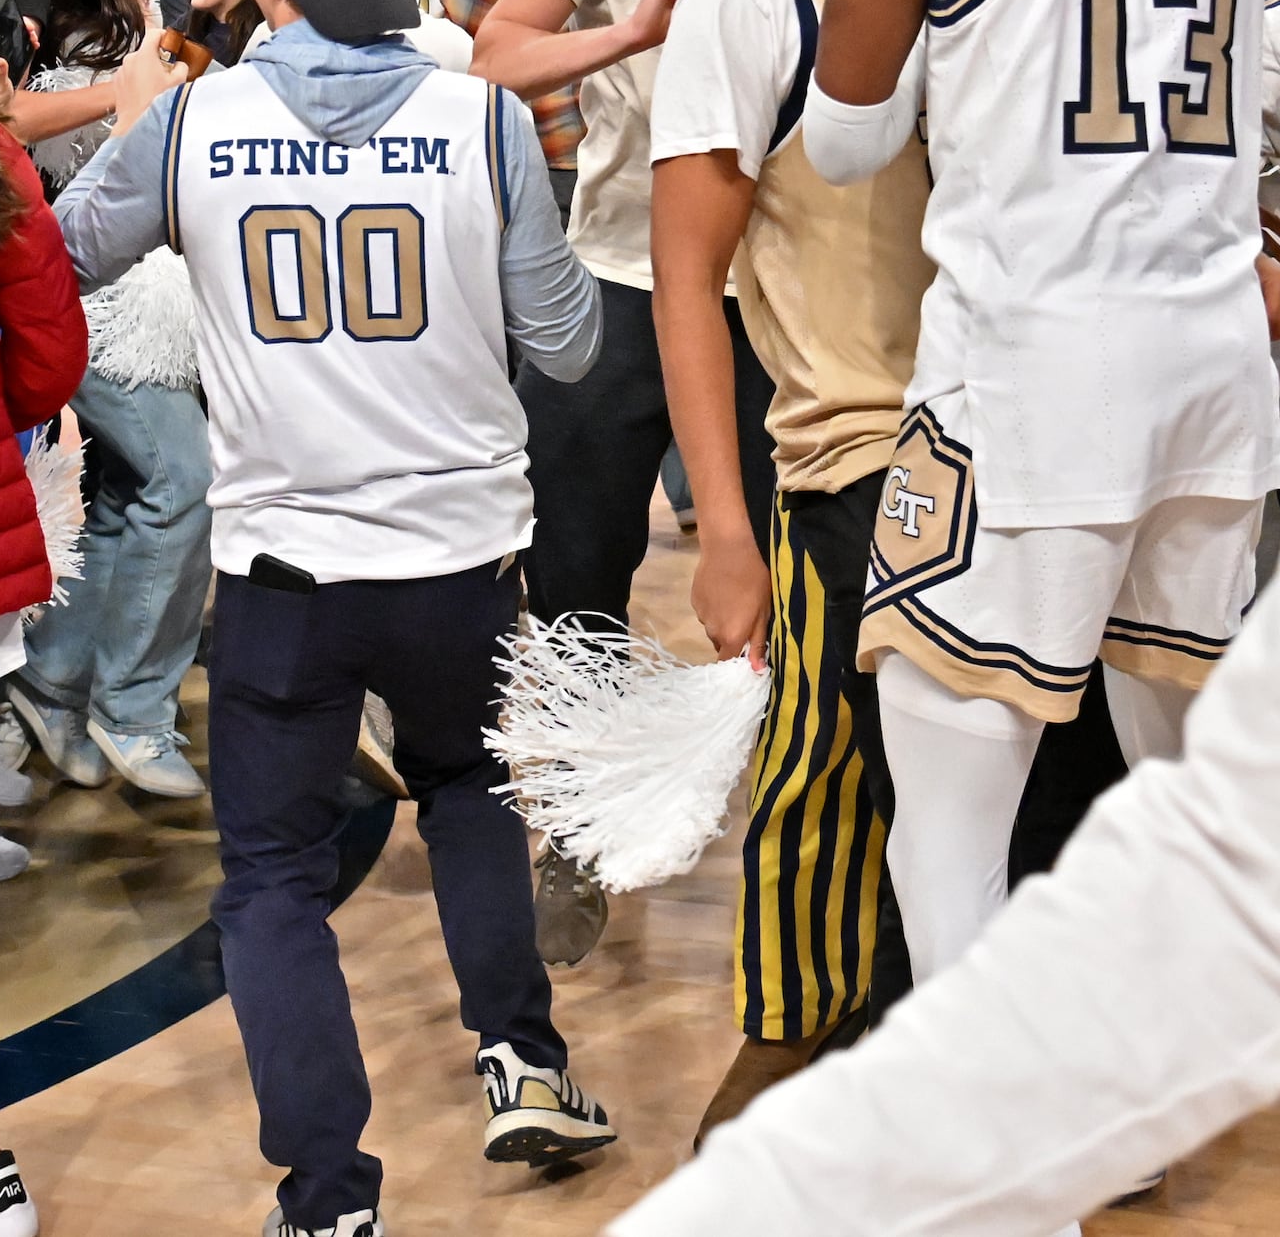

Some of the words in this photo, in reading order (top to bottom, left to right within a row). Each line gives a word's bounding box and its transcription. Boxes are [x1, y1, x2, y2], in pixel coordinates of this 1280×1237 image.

[209, 139, 350, 179] STING
[238, 203, 429, 344] 00
[882, 465, 936, 539] GT
